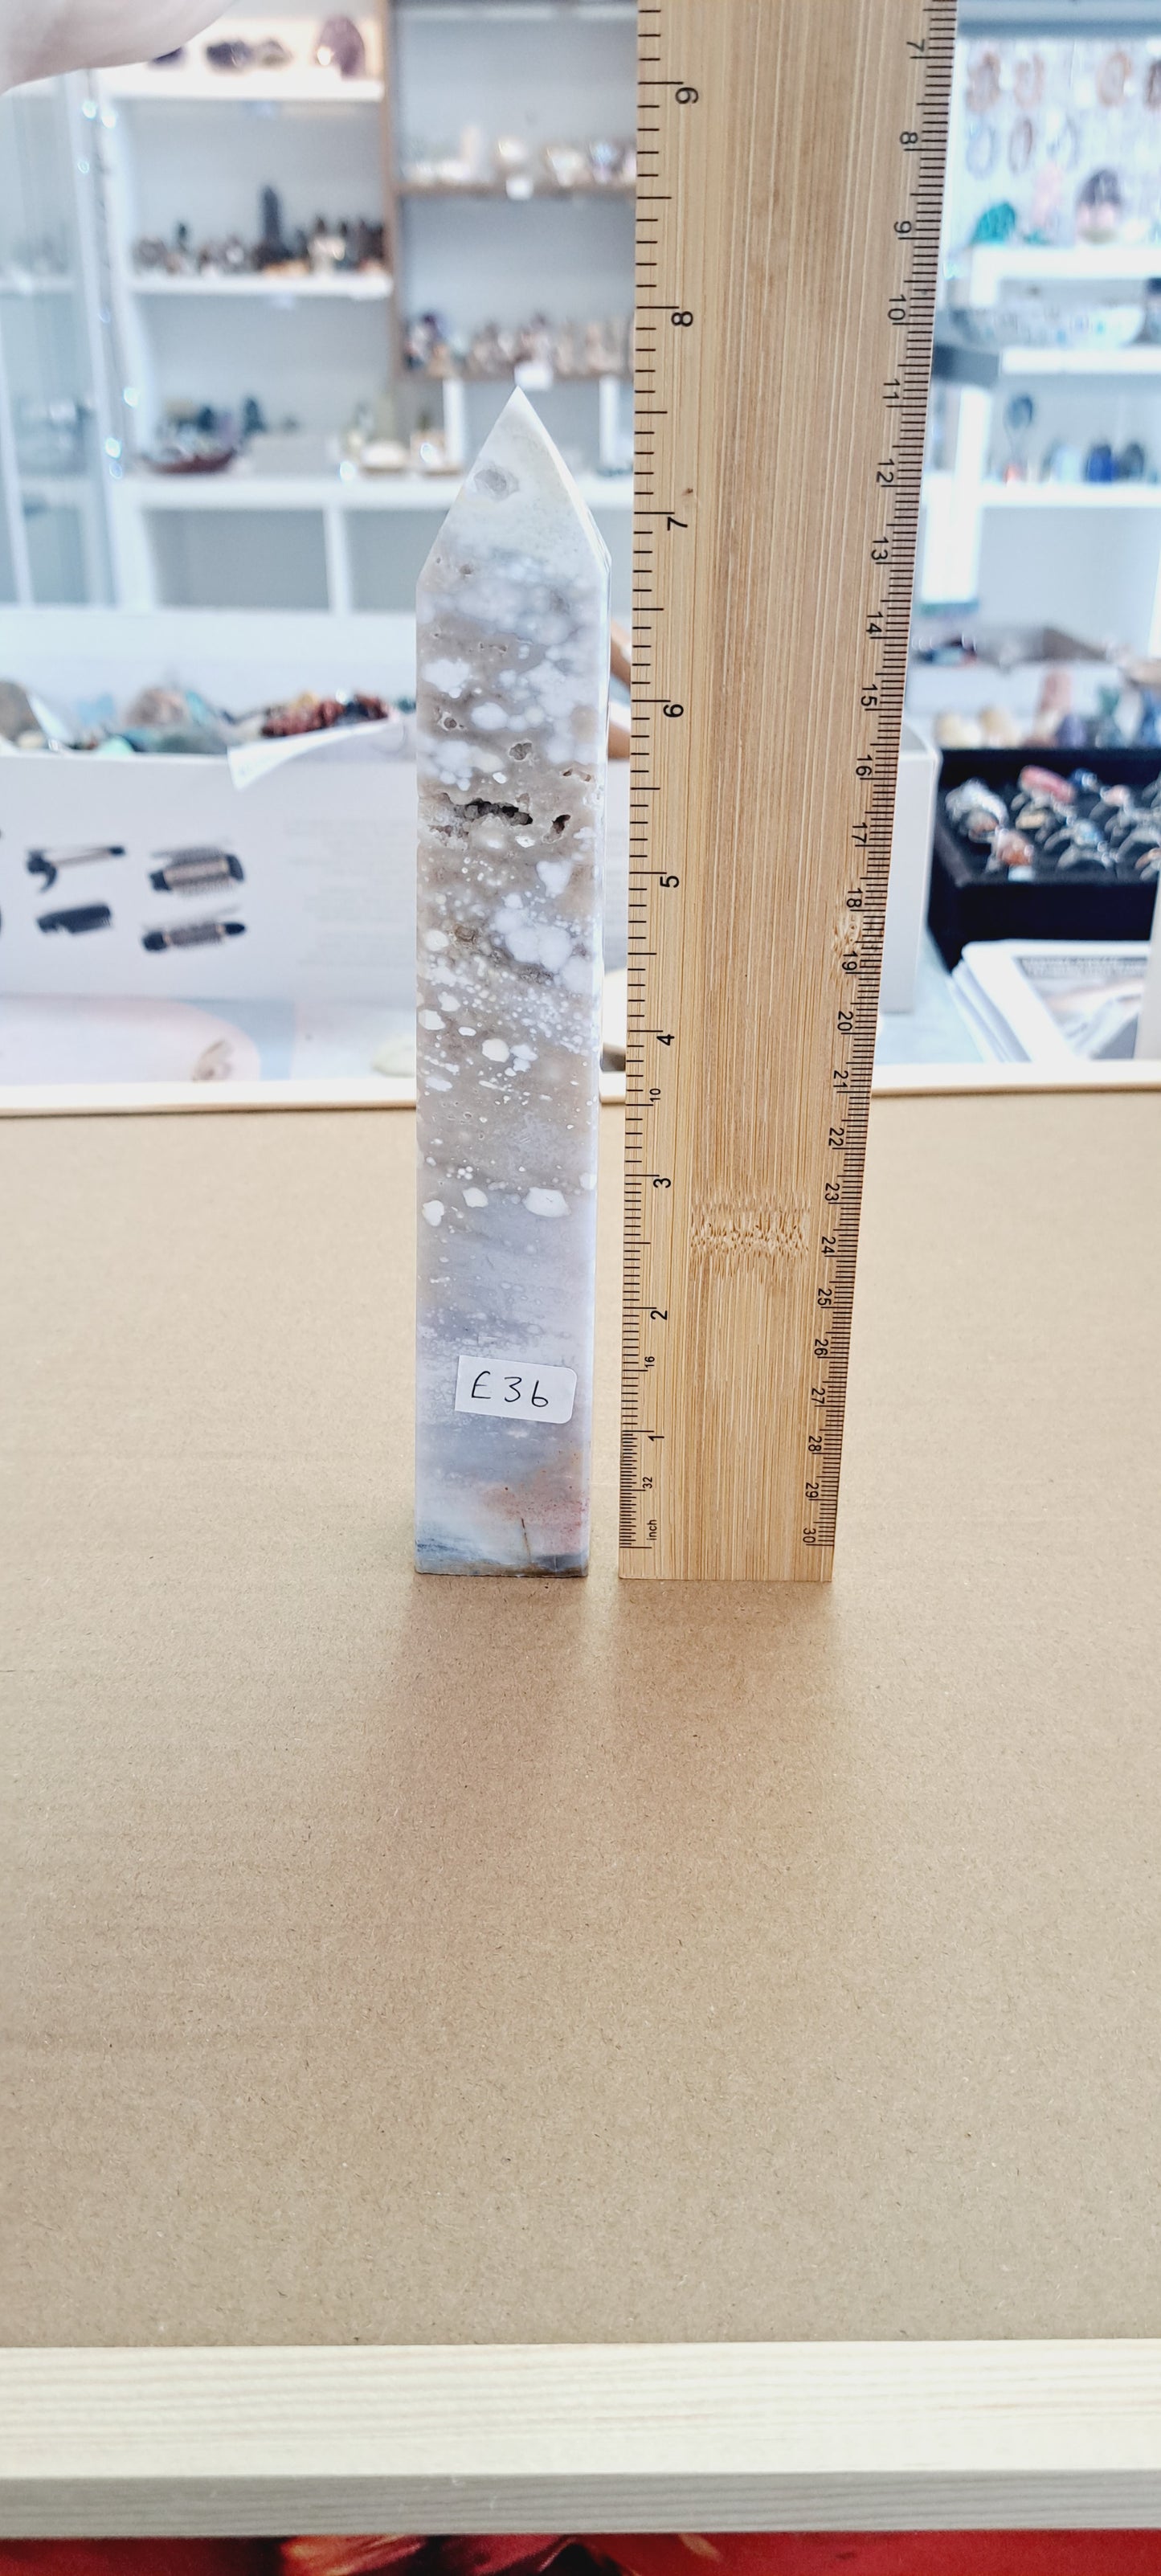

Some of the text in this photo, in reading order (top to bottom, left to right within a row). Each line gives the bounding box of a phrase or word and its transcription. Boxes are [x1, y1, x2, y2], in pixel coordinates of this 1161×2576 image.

[905, 39, 926, 54] 7
[675, 86, 699, 104] 9
[899, 130, 919, 145] 8
[893, 220, 913, 235] 9
[888, 294, 906, 321] 10
[670, 310, 693, 328] 8
[882, 378, 901, 401] 11
[876, 458, 895, 484] 12
[667, 517, 688, 532] 7
[870, 536, 889, 562] 13
[866, 611, 884, 635] 14
[861, 685, 878, 707] 15
[663, 702, 685, 718] 6
[856, 754, 873, 777] 16
[851, 822, 869, 844] 17
[660, 874, 681, 889] 5
[846, 887, 864, 909] 18
[841, 951, 859, 971] 19
[836, 1011, 853, 1032] 20
[656, 1034, 675, 1046] 4
[833, 1069, 849, 1089] 21
[649, 1088, 661, 1102] 10
[828, 1127, 844, 1147] 22
[653, 1177, 672, 1188] 3
[824, 1183, 840, 1202] 23
[821, 1237, 836, 1254] 24
[817, 1288, 832, 1306] 25
[650, 1310, 668, 1321] 2
[814, 1339, 828, 1356] 26
[644, 1355, 656, 1368] 16
[811, 1388, 826, 1405] 27
[808, 1436, 822, 1452] 28
[642, 1476, 653, 1489] 32
[805, 1482, 820, 1499] 29
[646, 1519, 657, 1541] inch
[803, 1527, 816, 1544] 30
